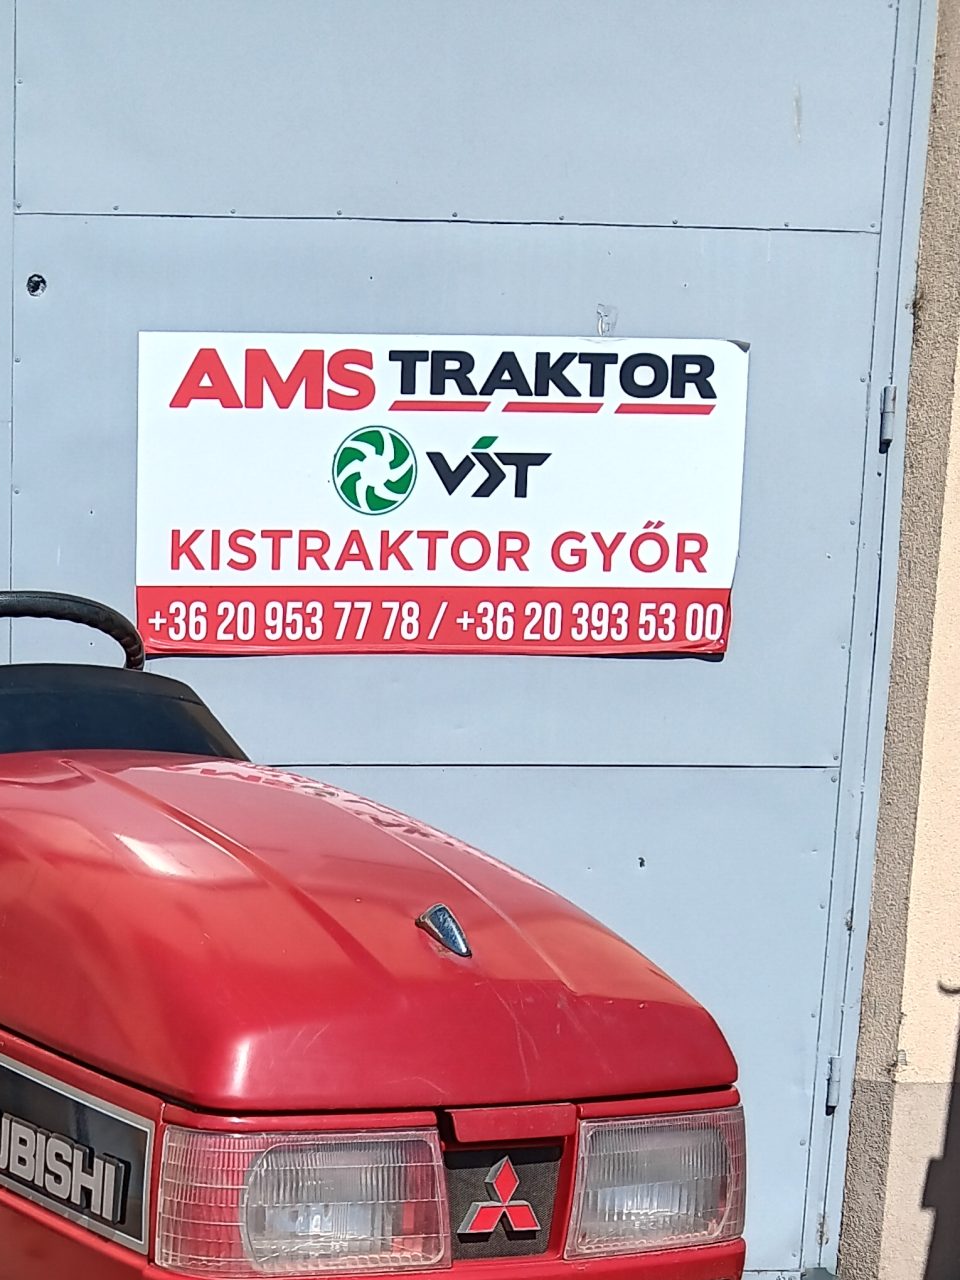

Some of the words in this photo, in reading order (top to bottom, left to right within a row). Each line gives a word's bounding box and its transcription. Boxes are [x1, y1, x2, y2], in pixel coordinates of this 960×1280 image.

[169, 348, 376, 411] AMS
[389, 350, 718, 399] TRAKTOR
[171, 529, 530, 571] KISTRAKTOR
[551, 520, 709, 573] GYŐR
[148, 602, 206, 641] +36
[217, 602, 255, 640] 20
[265, 602, 322, 640] 953
[334, 602, 371, 640] 77
[382, 602, 419, 640] 78
[456, 602, 514, 640] +36
[524, 602, 561, 640] 20
[572, 603, 628, 640] 393
[639, 603, 675, 640] 53
[686, 603, 724, 641] 00
